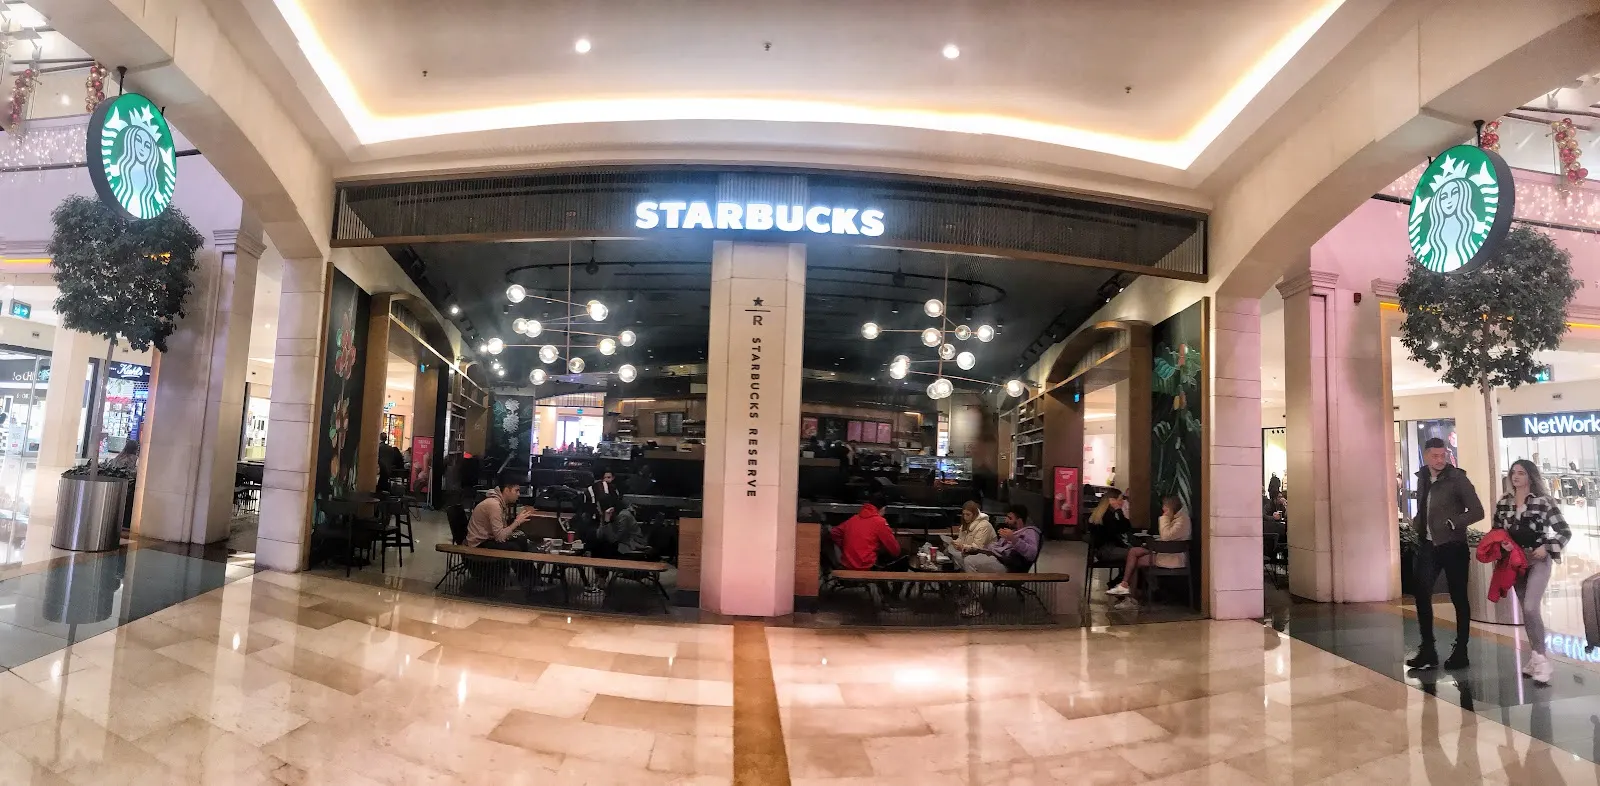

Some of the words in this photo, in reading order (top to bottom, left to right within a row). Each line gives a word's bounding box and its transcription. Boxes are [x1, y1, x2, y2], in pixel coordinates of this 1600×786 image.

[635, 201, 885, 237] STARBUCKS
[752, 315, 763, 326] R
[749, 337, 762, 418] STARBUCKS
[1524, 414, 1600, 435] NetWork
[746, 428, 758, 497] RESERVE
